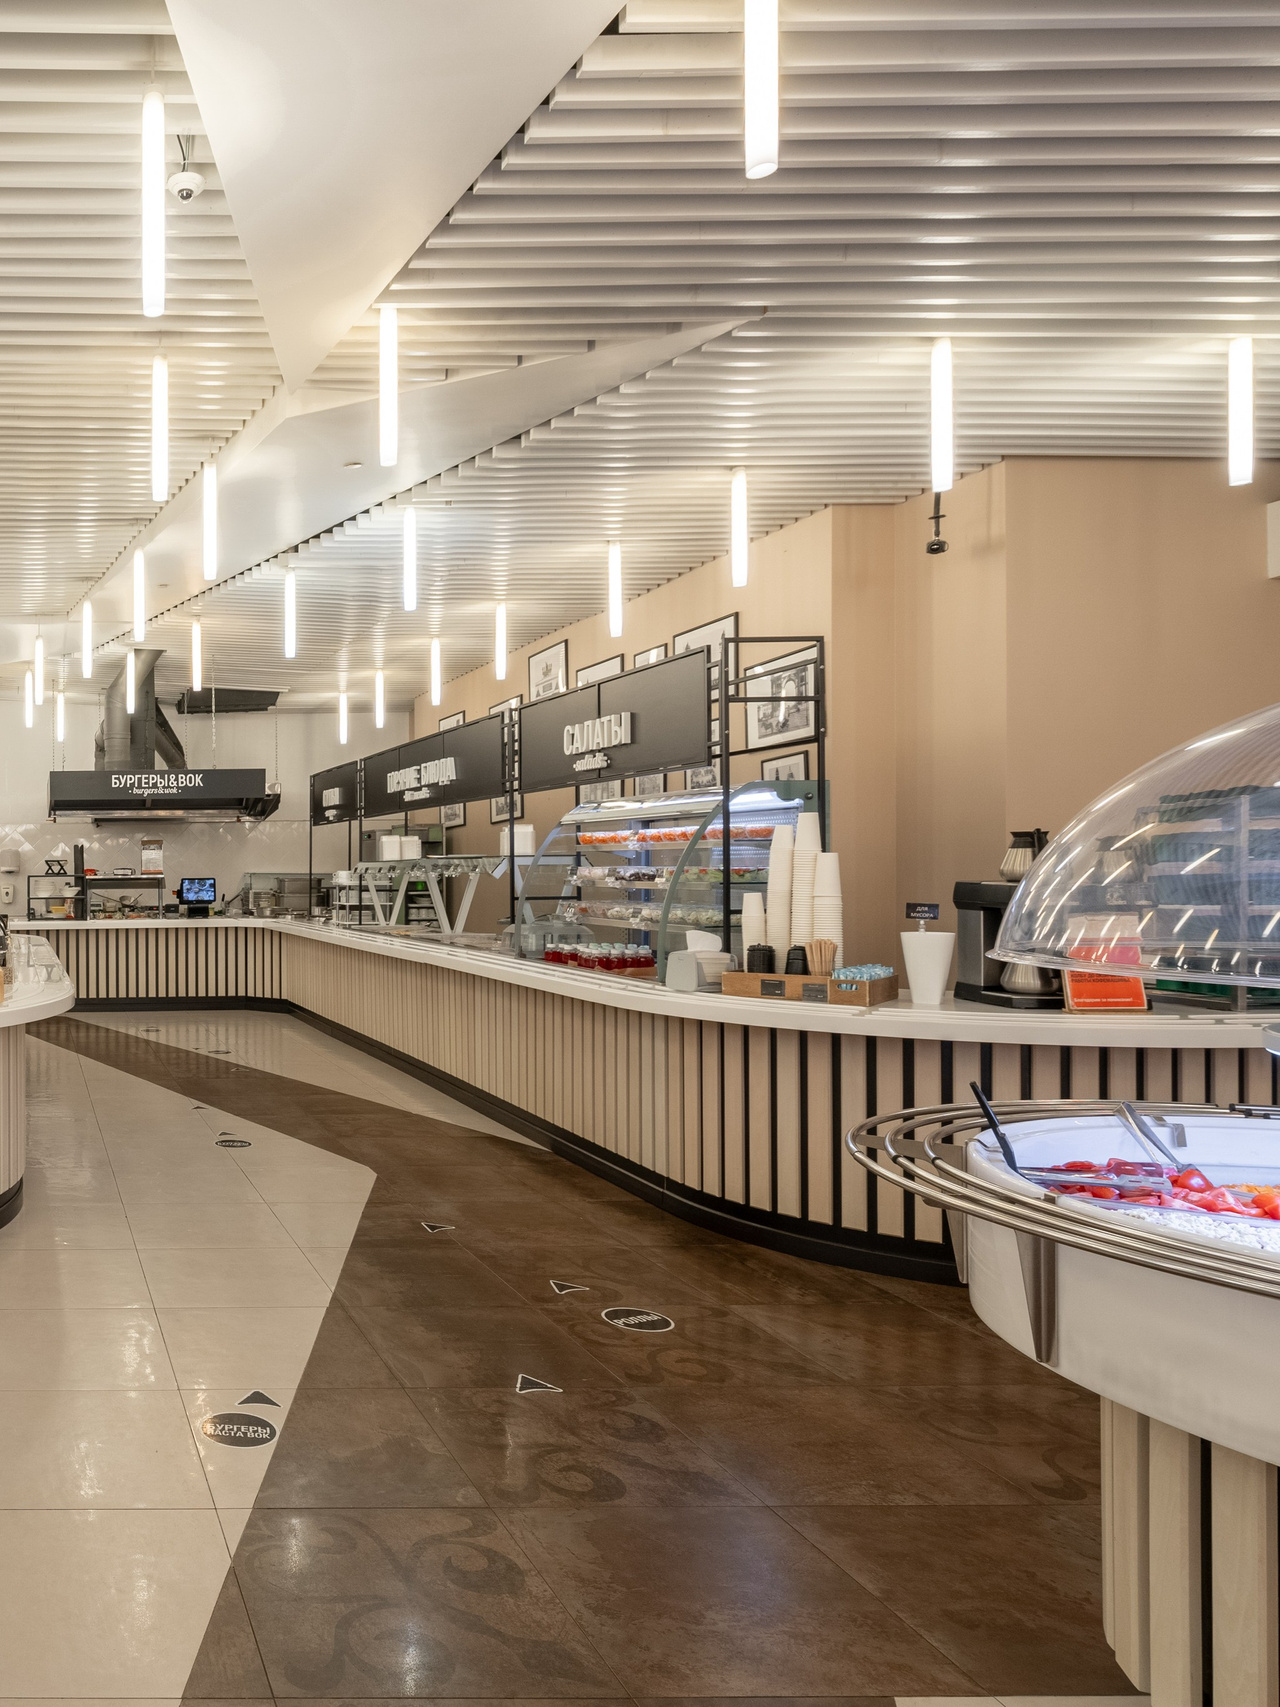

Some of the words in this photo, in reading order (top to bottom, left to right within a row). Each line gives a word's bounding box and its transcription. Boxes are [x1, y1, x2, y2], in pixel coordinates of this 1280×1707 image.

[563, 711, 631, 755] САЛАТЫ
[111, 773, 204, 788] БУРГЕРЫ&ВОК
[387, 765, 421, 793] ГОРЯЧИЕ
[421, 757, 456, 786] БЛЮДА
[132, 787, 178, 797] burgers&wok
[612, 1313, 662, 1326] РОЛЛЫ
[206, 1423, 271, 1434] БУРГЕРЫ
[206, 1430, 244, 1438] ПАСТА
